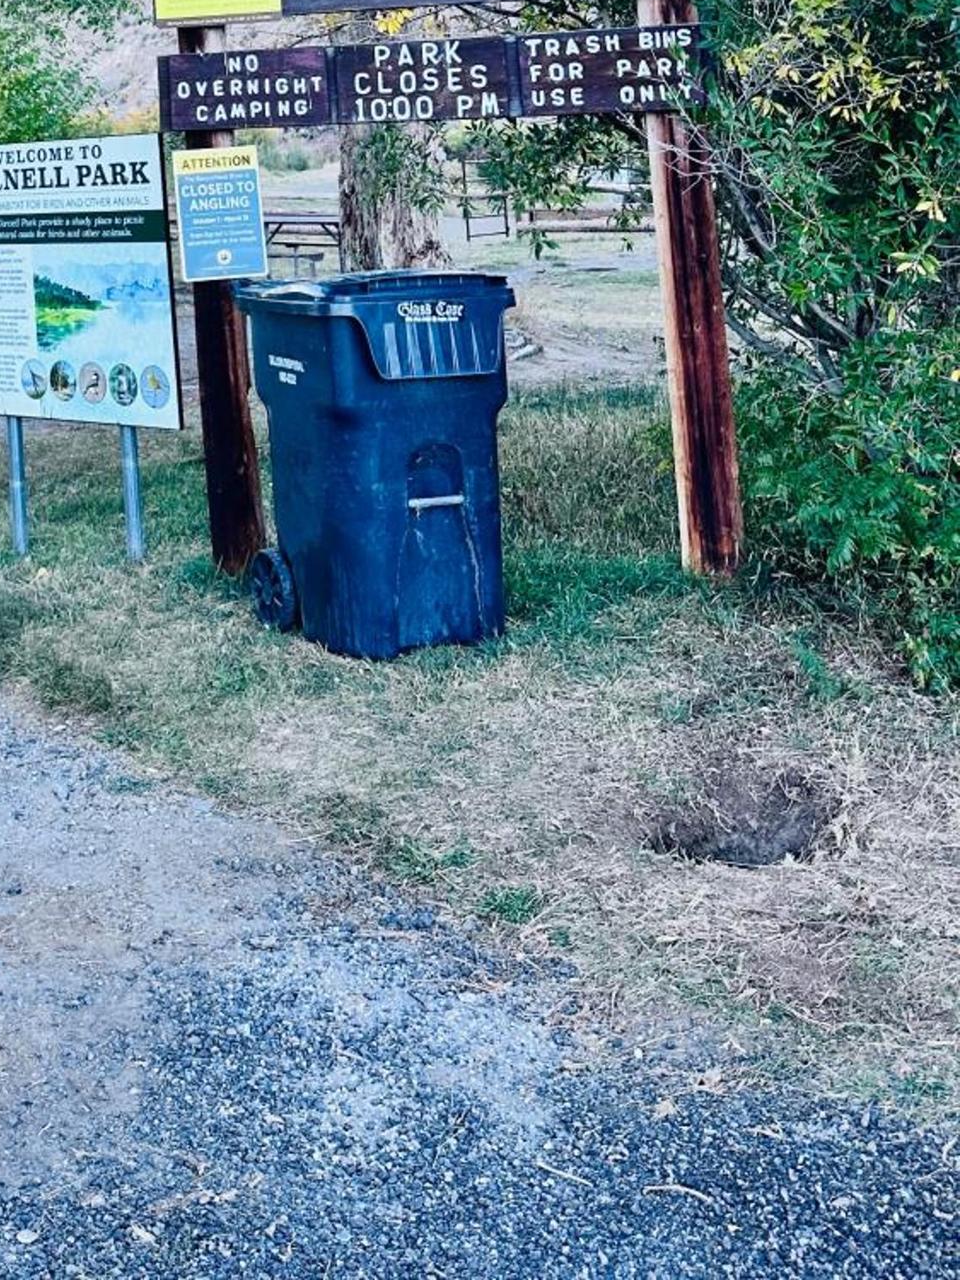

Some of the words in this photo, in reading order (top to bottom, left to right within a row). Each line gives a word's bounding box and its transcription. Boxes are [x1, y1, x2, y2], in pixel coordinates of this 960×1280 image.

[374, 40, 463, 68] PARK
[524, 33, 620, 58] TRASH
[638, 28, 692, 50] BINS
[227, 54, 259, 73] NO
[529, 62, 584, 83] FOR
[177, 76, 323, 99] OVERNIGHT
[354, 64, 488, 95] CLOSES
[355, 95, 434, 122] 10:00
[456, 91, 500, 118] PM
[531, 87, 585, 107] USE
[196, 99, 308, 122] CAMPING
[79, 144, 103, 160] TO
[182, 155, 251, 170] ATTENTION
[76, 161, 151, 187] PARK
[181, 182, 234, 198] CLOSED
[236, 180, 256, 194] TO
[189, 195, 250, 212] ANGLING
